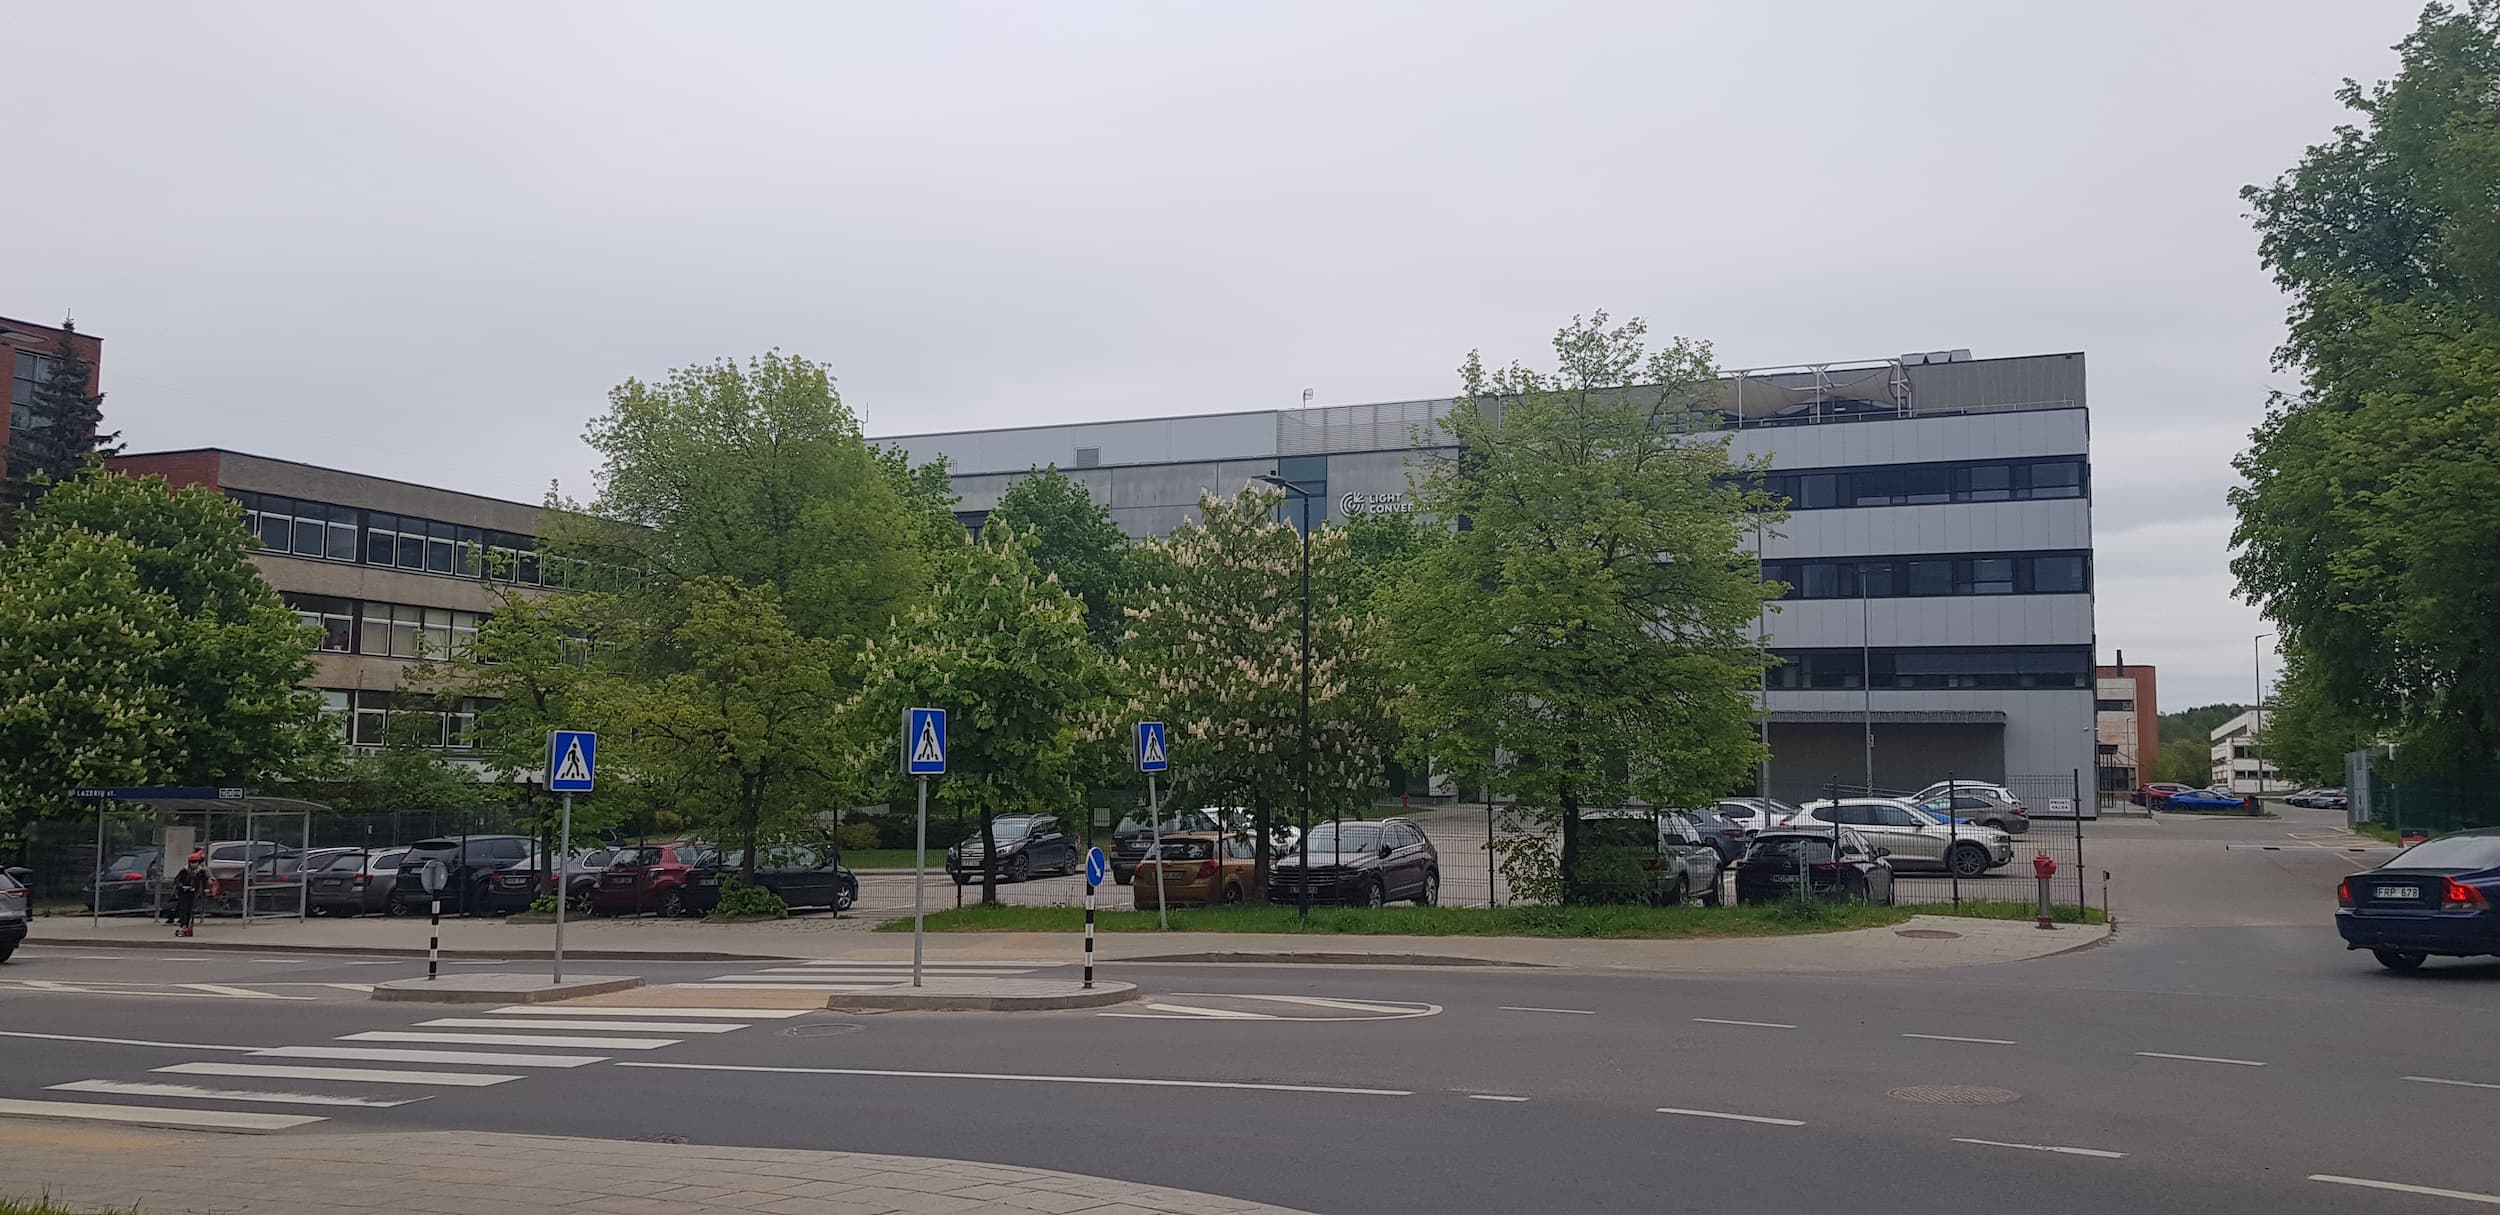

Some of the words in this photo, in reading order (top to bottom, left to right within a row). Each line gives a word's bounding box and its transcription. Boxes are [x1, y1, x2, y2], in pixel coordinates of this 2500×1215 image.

[1369, 493, 1402, 504] LIGHT
[2378, 887, 2396, 897] FRP
[2401, 887, 2418, 897] 678
